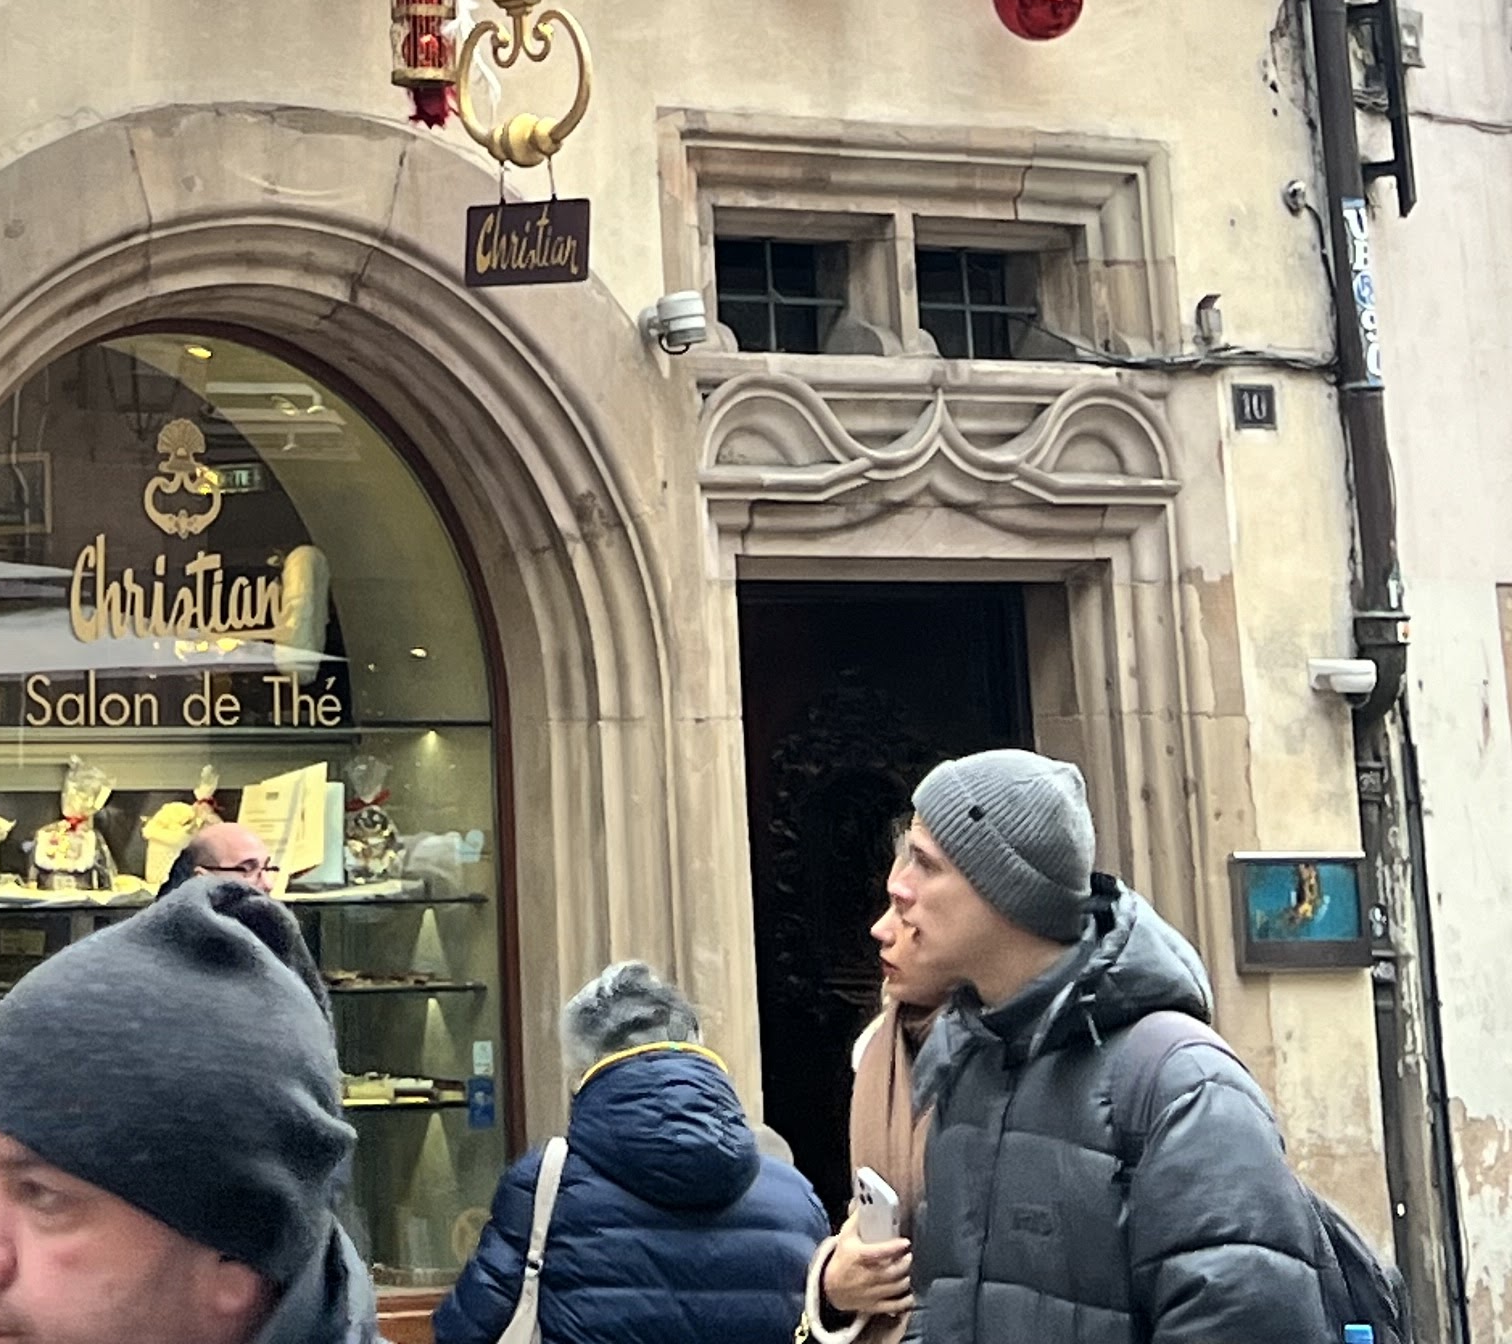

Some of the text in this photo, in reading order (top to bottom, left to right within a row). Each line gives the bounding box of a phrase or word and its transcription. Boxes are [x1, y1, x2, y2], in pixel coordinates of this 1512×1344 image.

[476, 204, 579, 275] Christian
[1242, 391, 1267, 420] 10
[70, 533, 296, 644] Christian
[26, 669, 343, 727] Salon de Thé
